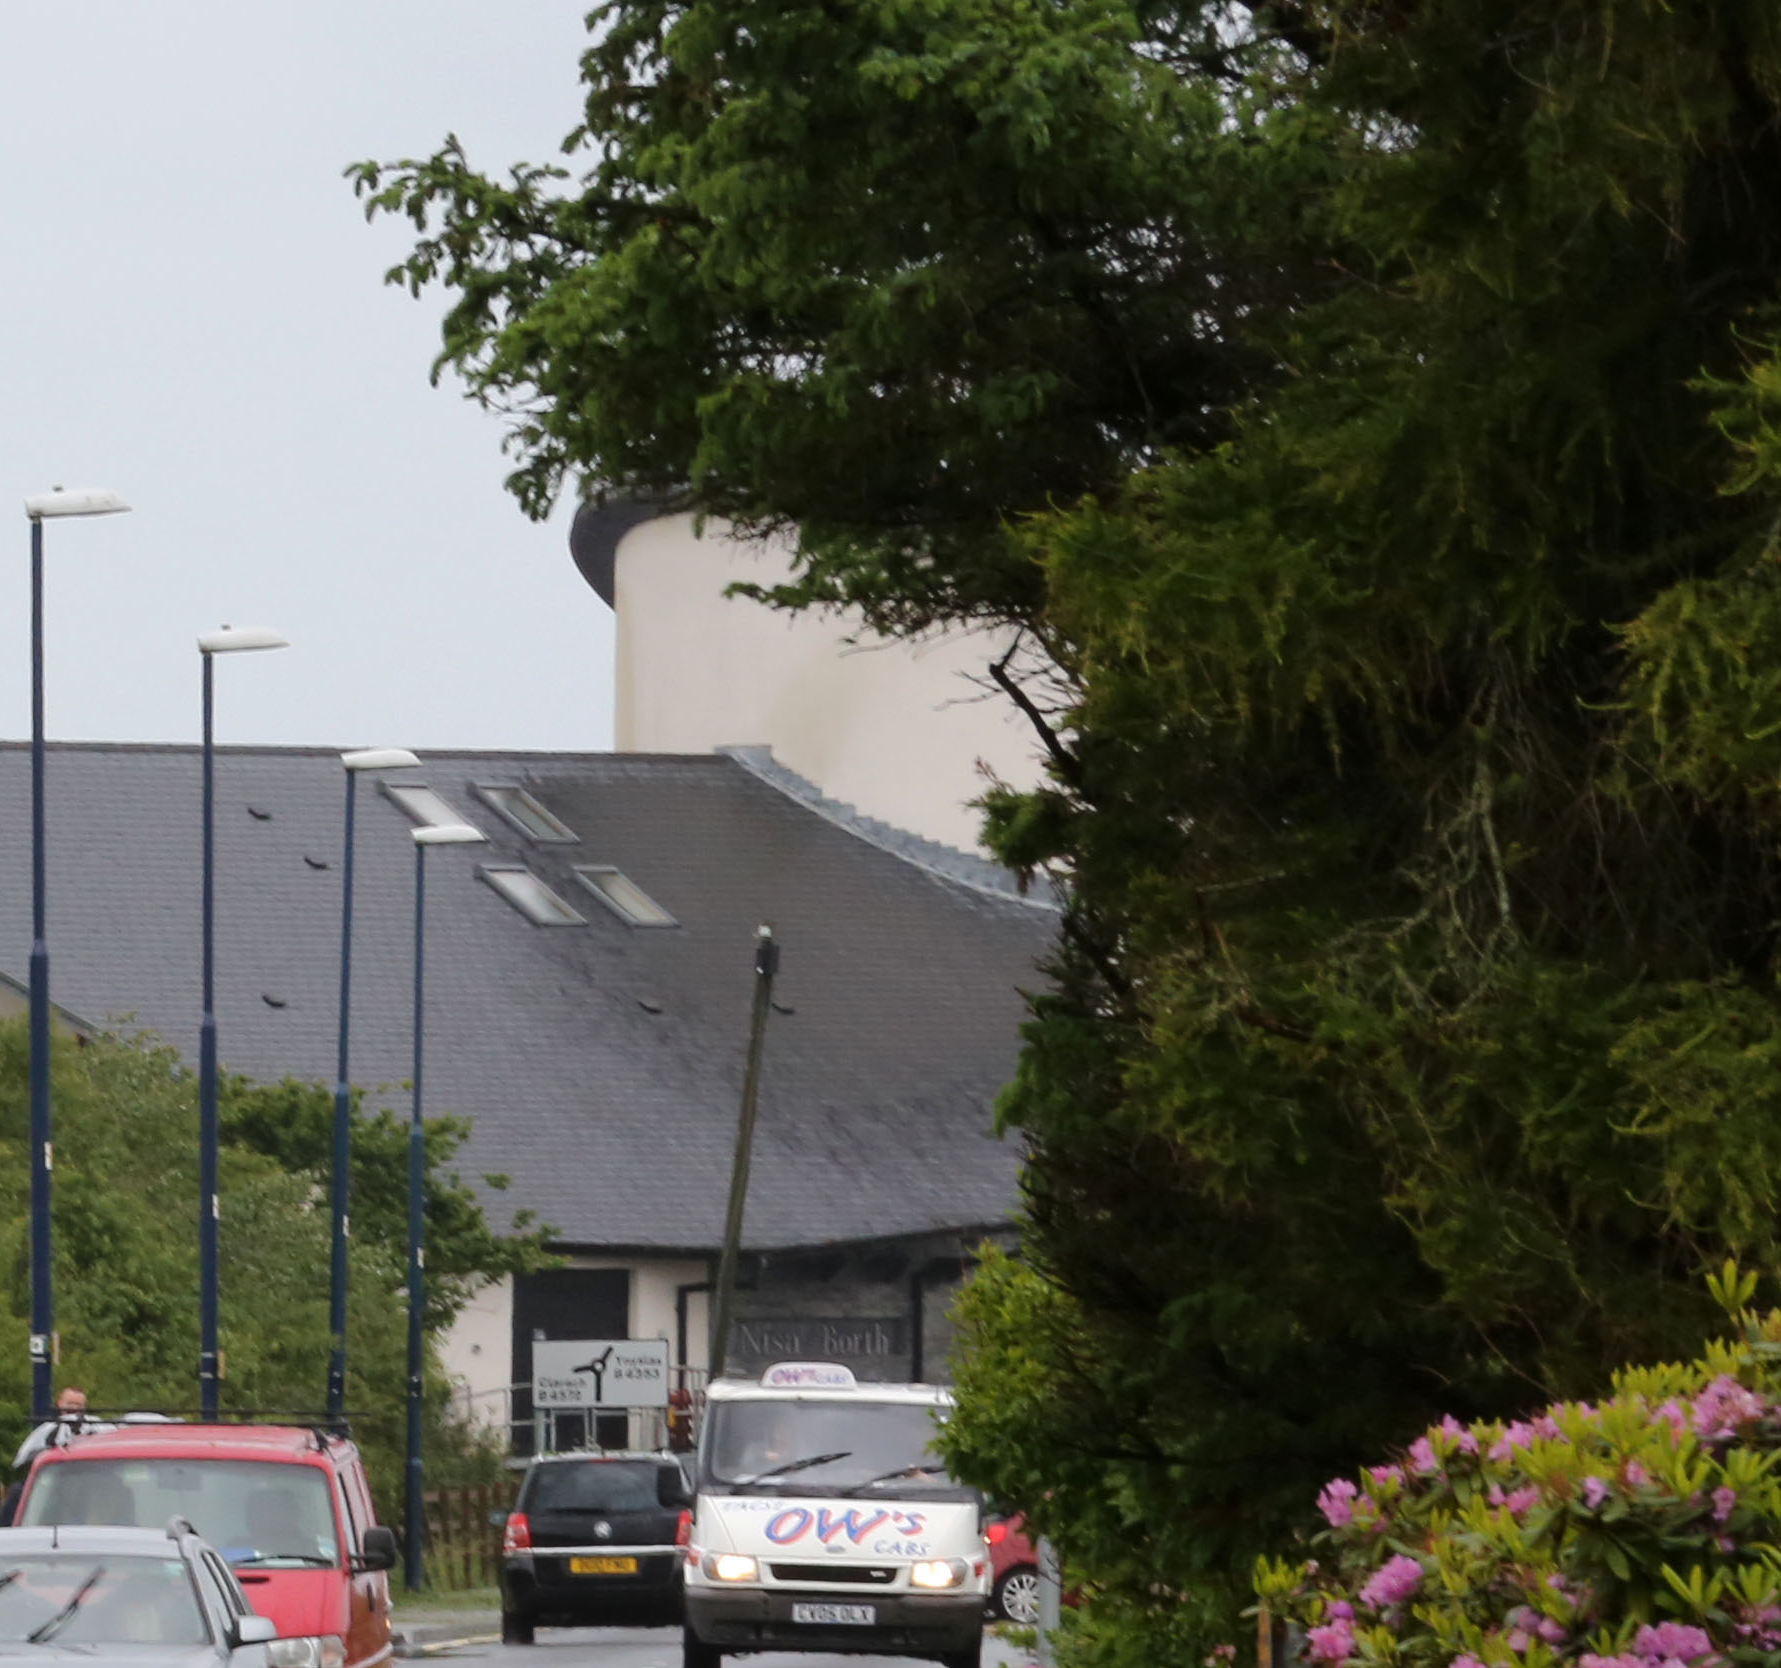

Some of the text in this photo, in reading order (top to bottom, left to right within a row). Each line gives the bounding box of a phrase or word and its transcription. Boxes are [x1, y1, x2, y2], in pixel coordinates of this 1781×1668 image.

[740, 1323, 889, 1355] Nisa Borth
[873, 1539, 932, 1557] CABS
